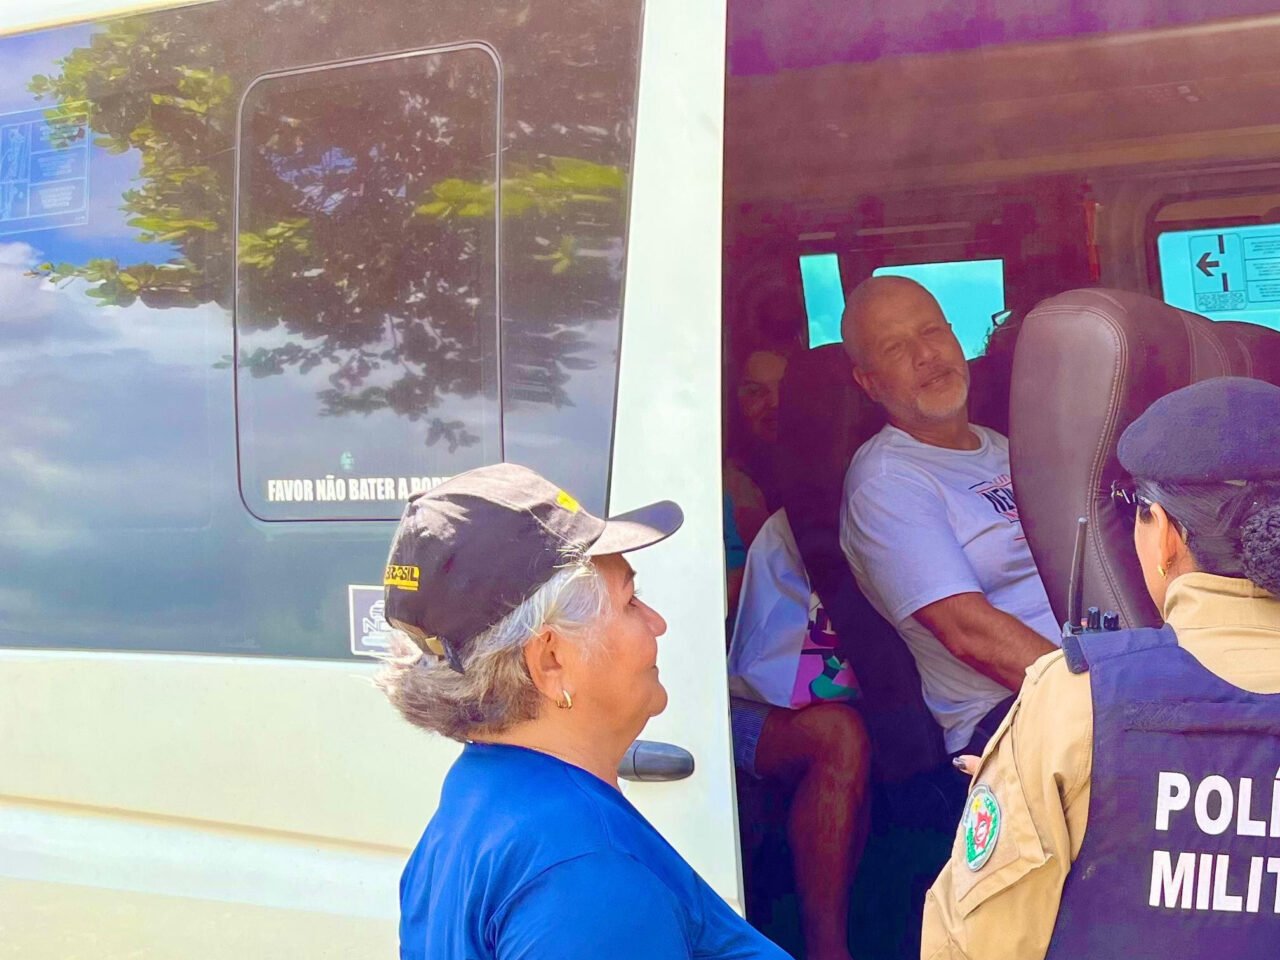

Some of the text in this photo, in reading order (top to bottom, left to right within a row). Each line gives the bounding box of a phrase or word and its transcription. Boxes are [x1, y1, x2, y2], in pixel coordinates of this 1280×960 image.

[268, 480, 314, 501] FAVOR
[316, 475, 346, 501] NÃO
[349, 478, 395, 499] BATER
[398, 477, 408, 499] A
